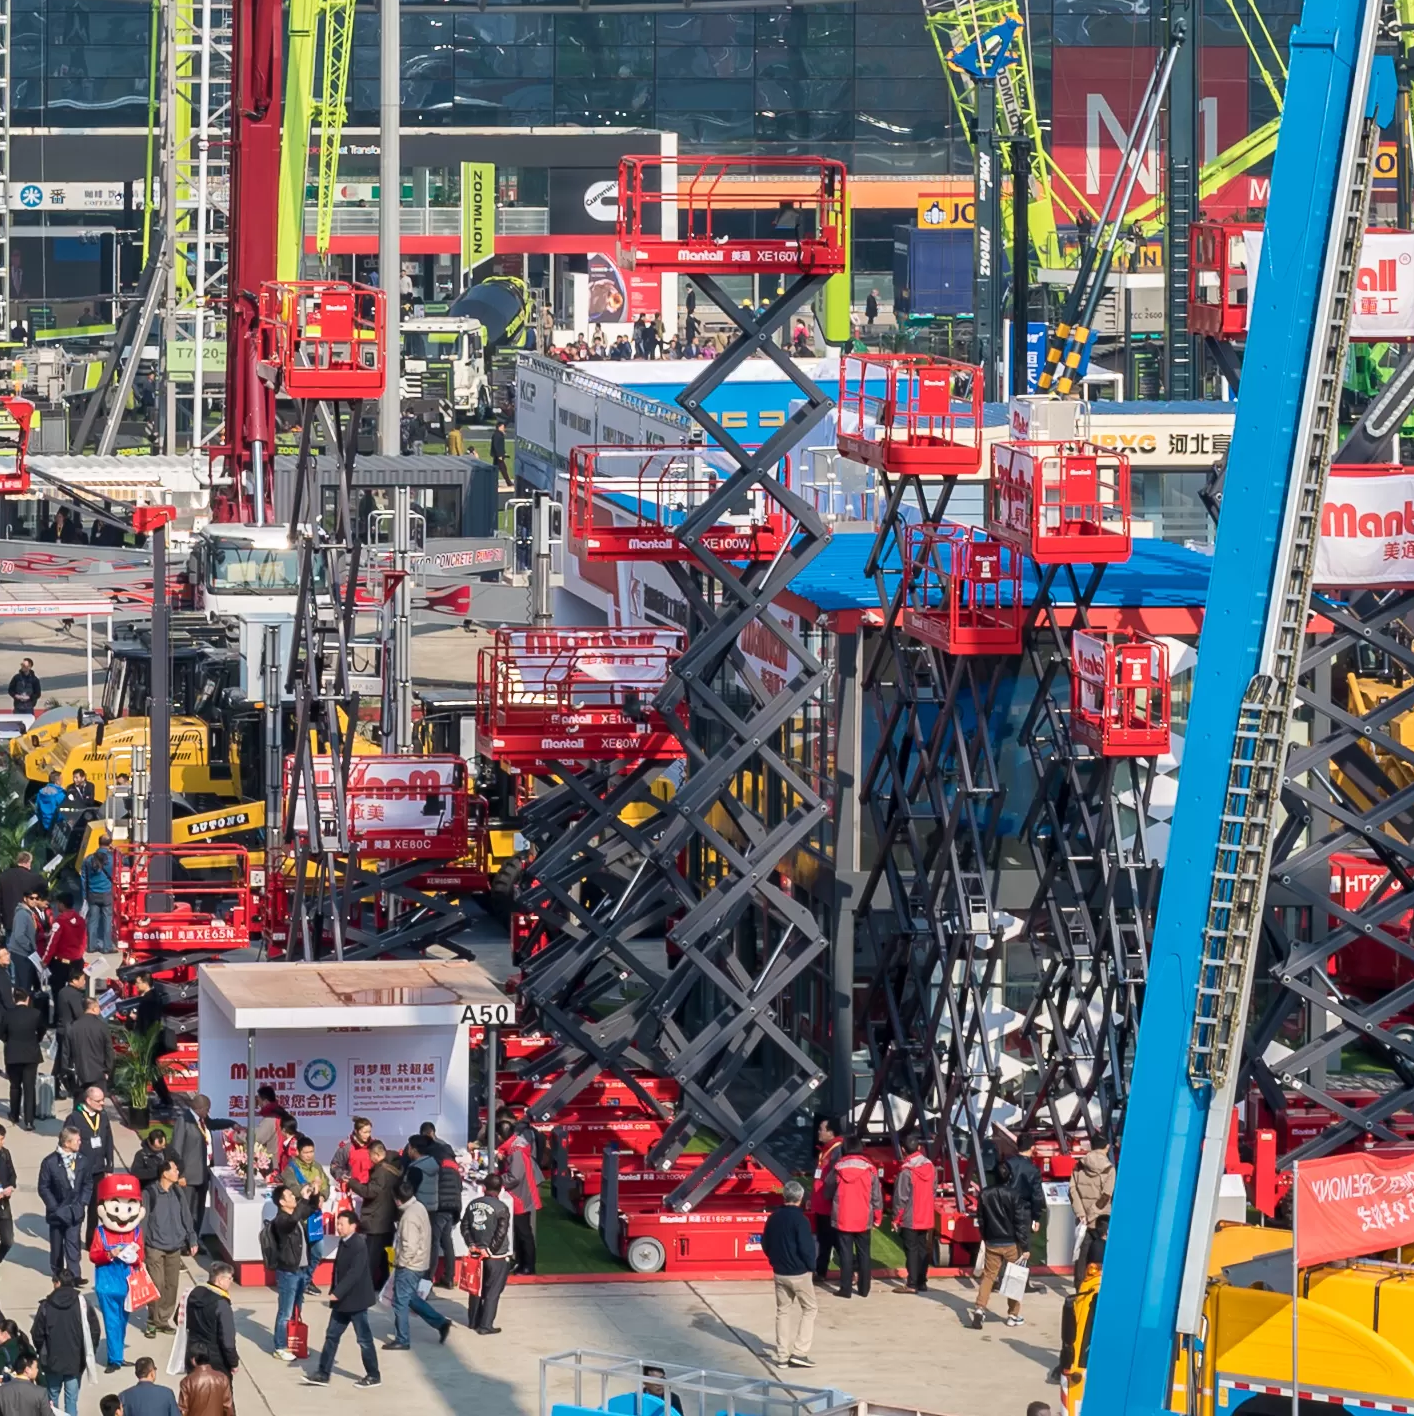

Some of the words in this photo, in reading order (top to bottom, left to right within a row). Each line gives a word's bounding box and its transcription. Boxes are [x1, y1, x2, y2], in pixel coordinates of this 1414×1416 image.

[473, 170, 482, 254] ZOOMLION
[678, 249, 724, 262] Mantall
[628, 538, 673, 550] Mantall
[702, 537, 751, 550] XE100W
[1, 560, 15, 574] 70
[436, 552, 473, 569] CONCRETE
[542, 737, 585, 749] Mantall
[601, 738, 641, 749] XE80W
[191, 813, 246, 834] LUTONG
[196, 928, 235, 940] XE65N
[460, 1005, 509, 1025] A50
[230, 1062, 296, 1080] Mntall
[353, 1063, 391, 1076] 同梦想
[397, 1063, 435, 1076] 共超越
